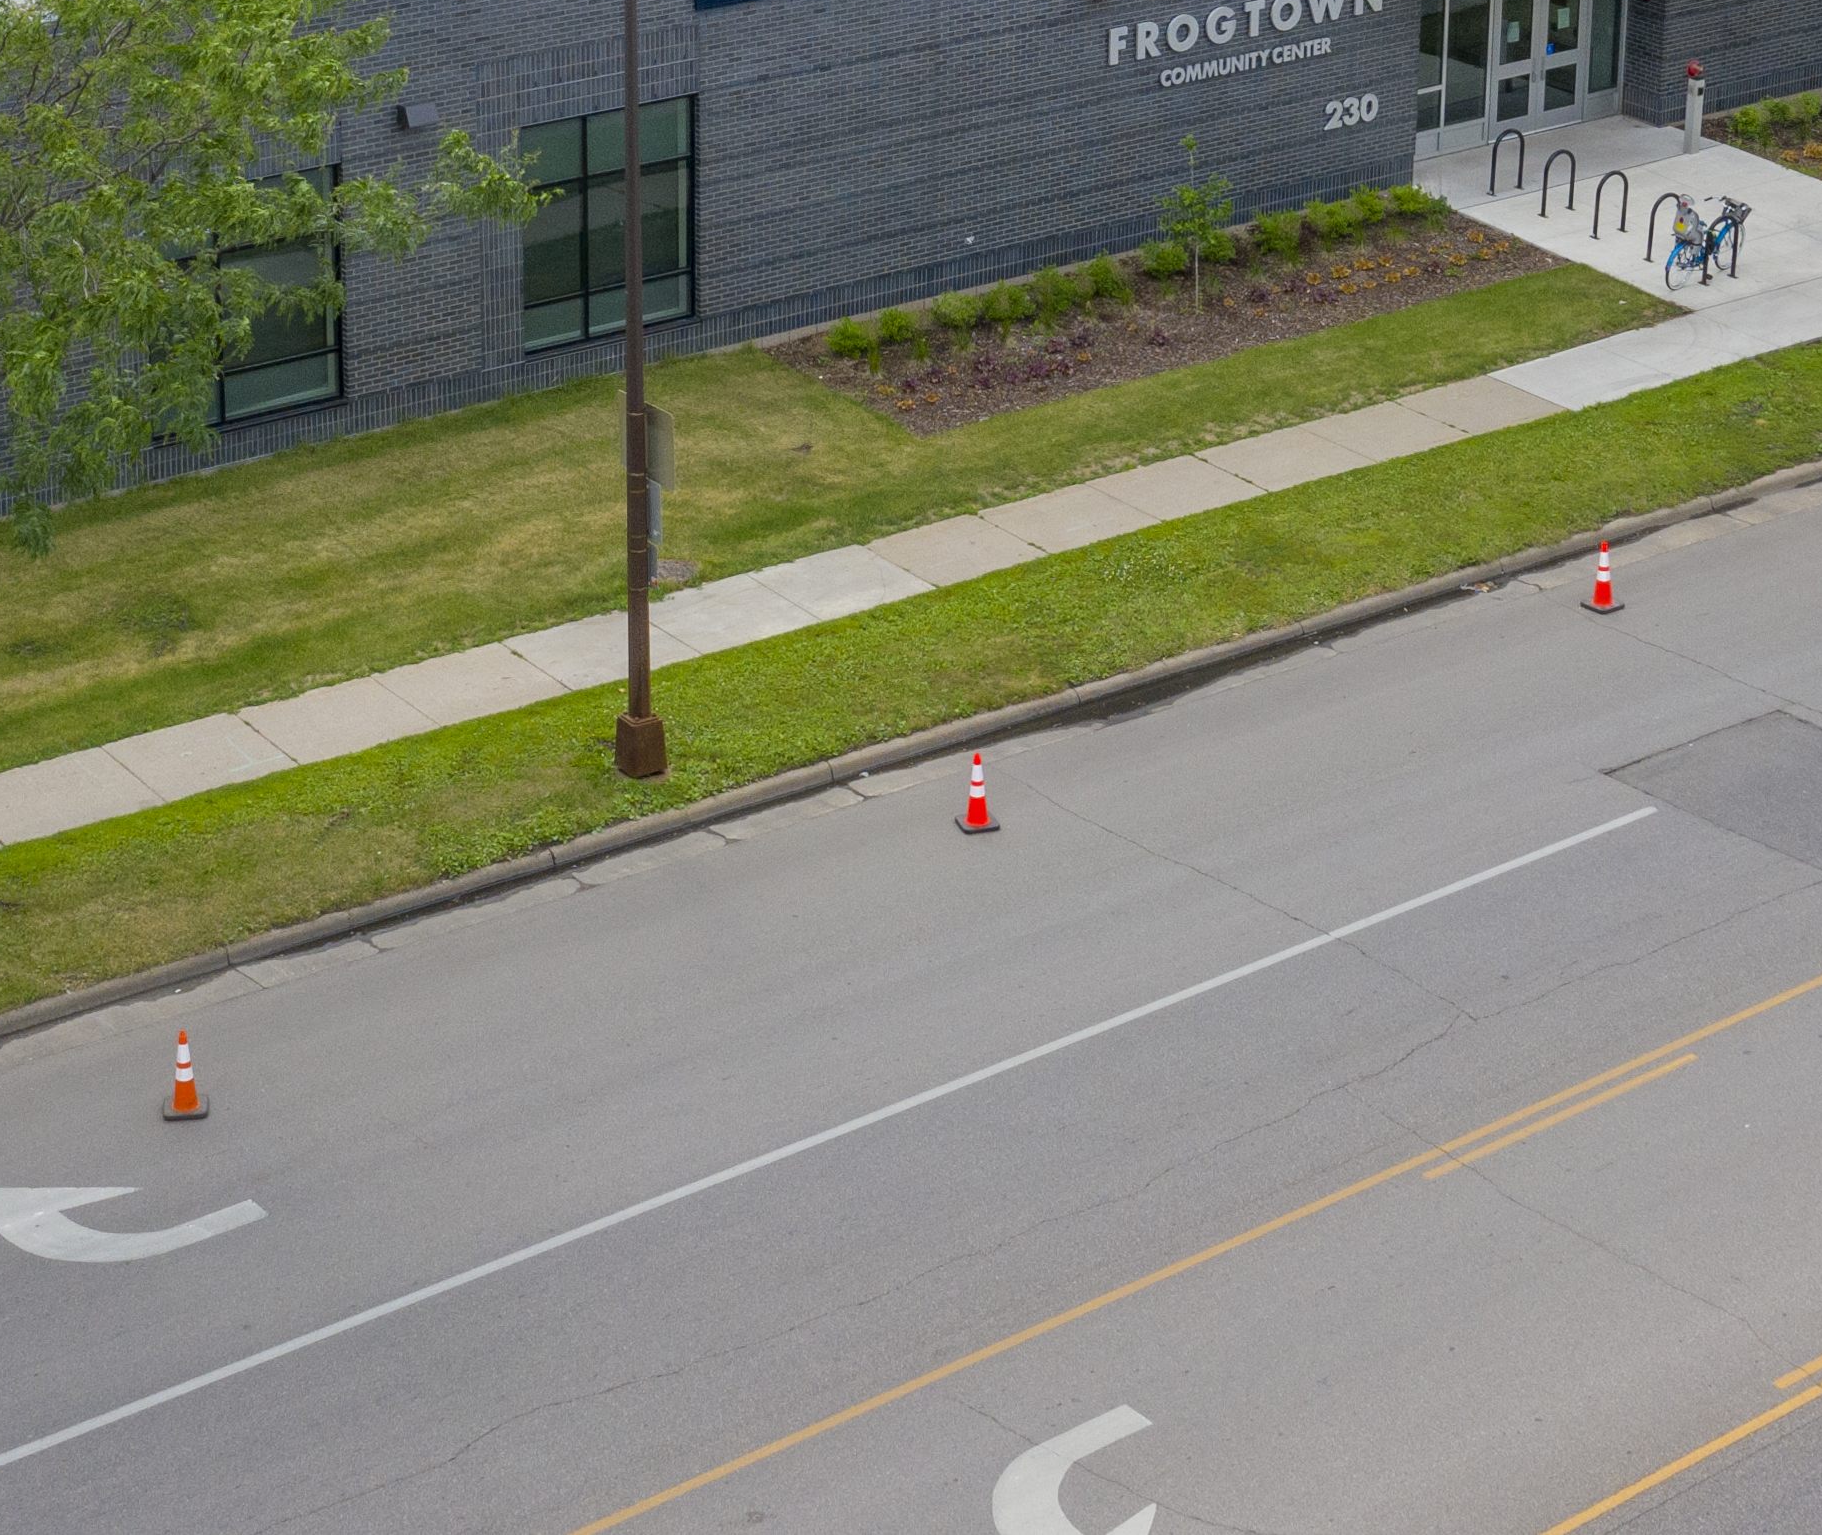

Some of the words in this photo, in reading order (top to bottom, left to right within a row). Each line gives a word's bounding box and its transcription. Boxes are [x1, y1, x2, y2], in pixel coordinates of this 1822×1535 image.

[1160, 48, 1271, 87] COMMUNITY
[1272, 37, 1332, 64] CENTER
[1323, 93, 1379, 131] 230
